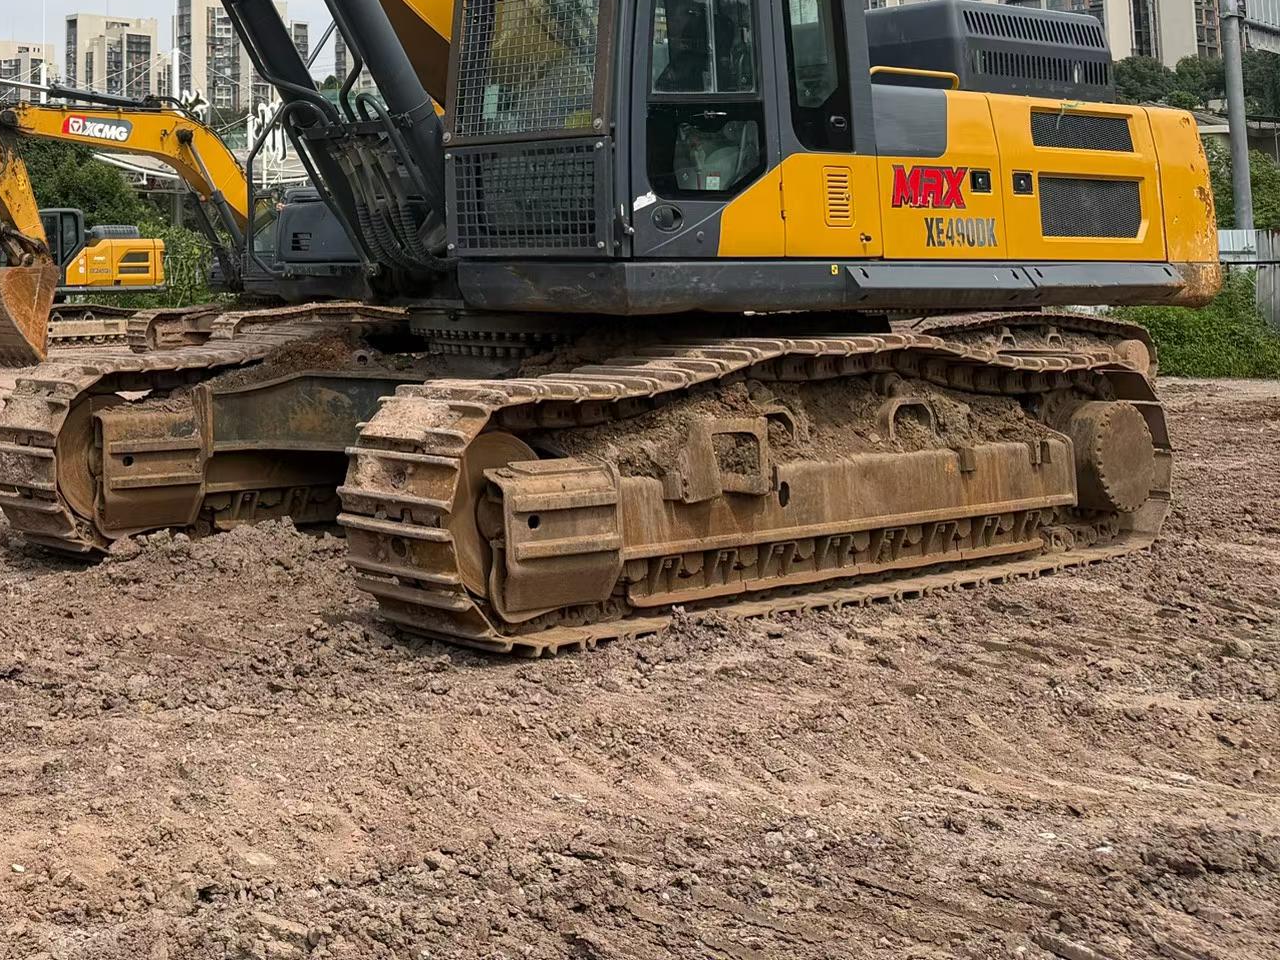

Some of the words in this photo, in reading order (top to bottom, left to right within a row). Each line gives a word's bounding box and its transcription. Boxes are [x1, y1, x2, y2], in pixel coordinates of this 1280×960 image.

[82, 121, 128, 141] XCMG
[892, 164, 968, 209] MAX
[924, 217, 998, 247] XE490DK
